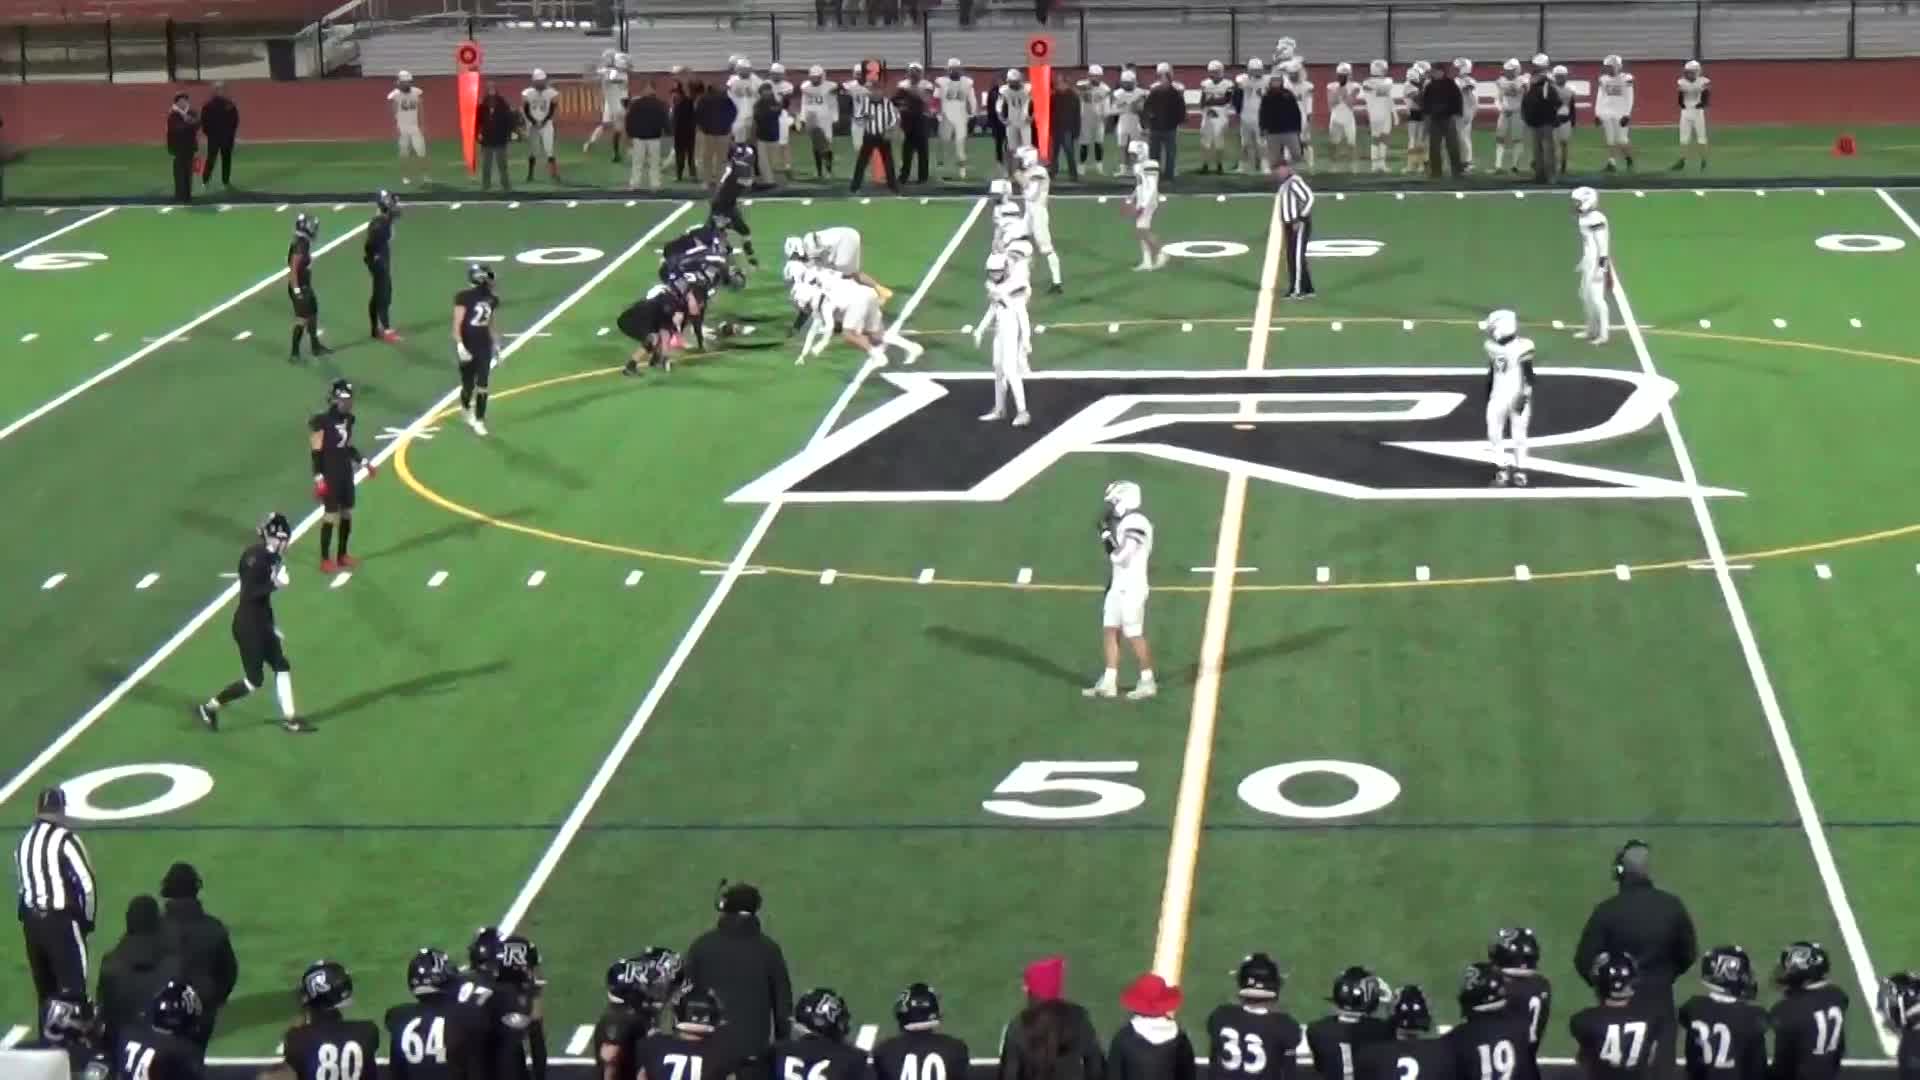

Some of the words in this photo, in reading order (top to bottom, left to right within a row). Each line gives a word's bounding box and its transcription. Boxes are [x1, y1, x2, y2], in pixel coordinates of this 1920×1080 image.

[316, 1040, 363, 1080] 80
[401, 1016, 447, 1064] 64
[1220, 1027, 1266, 1074] 33
[1478, 1040, 1515, 1080] 19
[1600, 1021, 1647, 1068] 47
